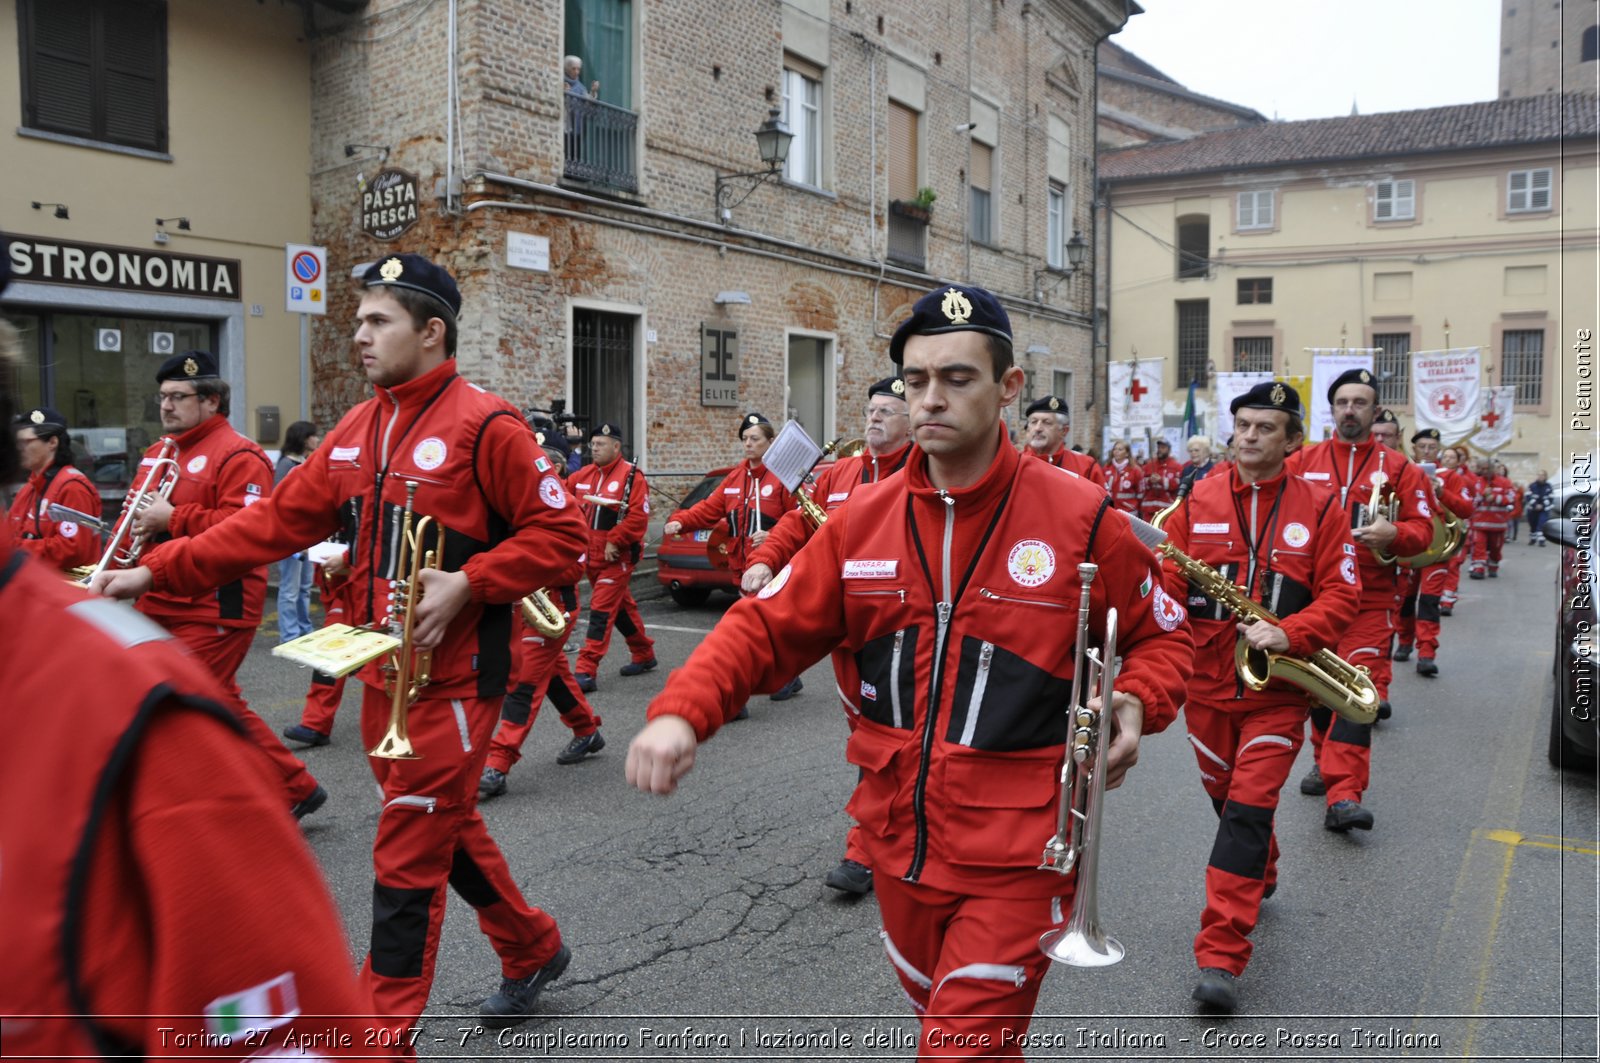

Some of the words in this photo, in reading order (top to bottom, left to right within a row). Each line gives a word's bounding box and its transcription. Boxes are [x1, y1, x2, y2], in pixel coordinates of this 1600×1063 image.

[364, 182, 415, 211] PASTA
[364, 204, 416, 229] FRESCA
[1417, 359, 1444, 369] CROCE
[1446, 357, 1476, 367] ROSSA
[1427, 367, 1466, 377] ITALIANA
[705, 388, 737, 400] ELITE
[1009, 546, 1021, 563] CROCE
[1012, 571, 1048, 584] FANFARA
